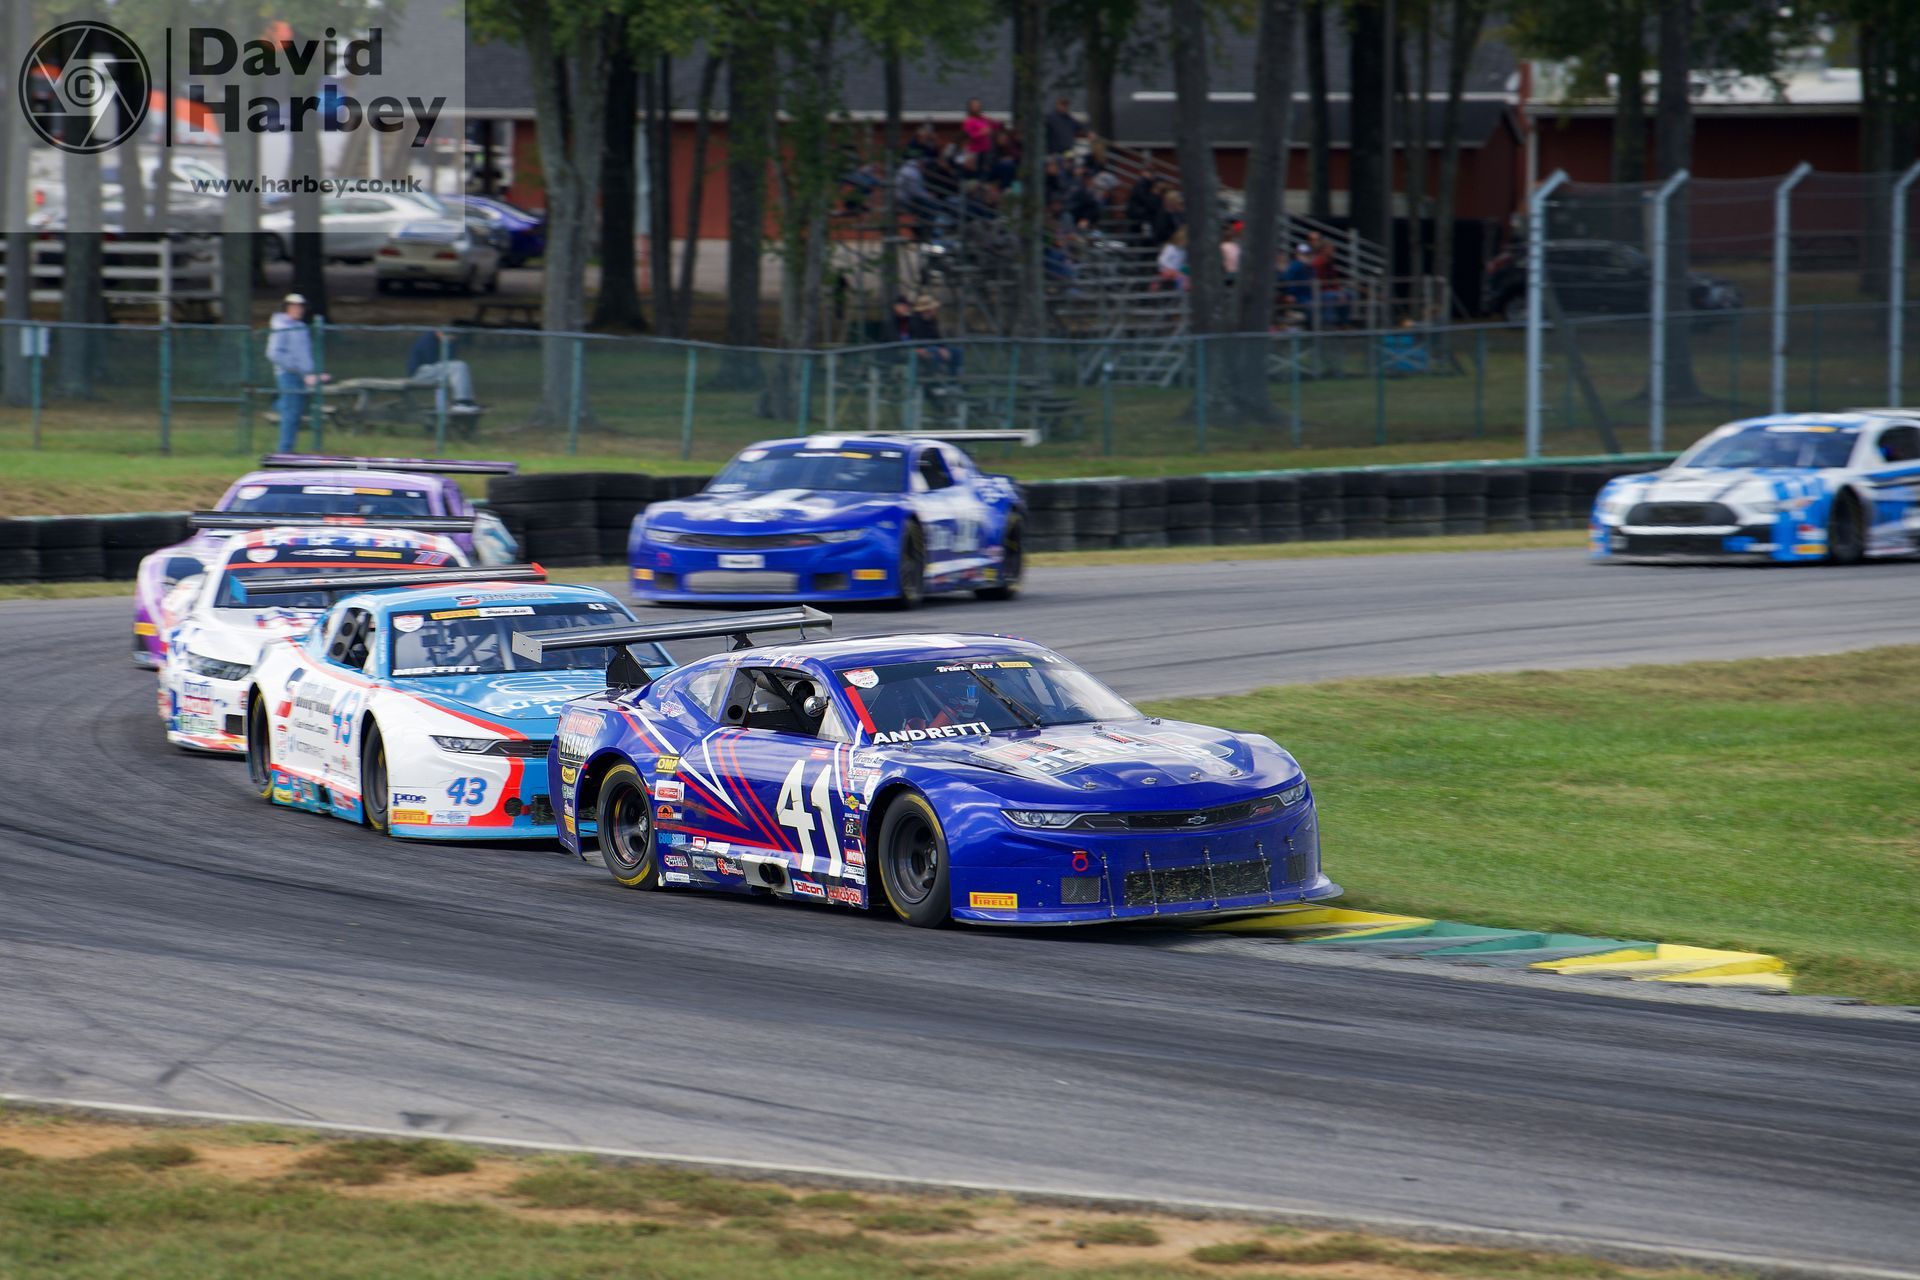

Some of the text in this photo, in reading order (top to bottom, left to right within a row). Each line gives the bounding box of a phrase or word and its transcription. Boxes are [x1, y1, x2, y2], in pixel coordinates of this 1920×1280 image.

[972, 662, 993, 670] Am
[873, 721, 992, 745] ANDRETTI
[657, 758, 678, 770] OMP
[446, 777, 488, 805] 43
[393, 792, 426, 806] pme
[777, 760, 843, 877] 41
[794, 881, 824, 896] tilton
[972, 895, 1017, 910] PIRELLI
